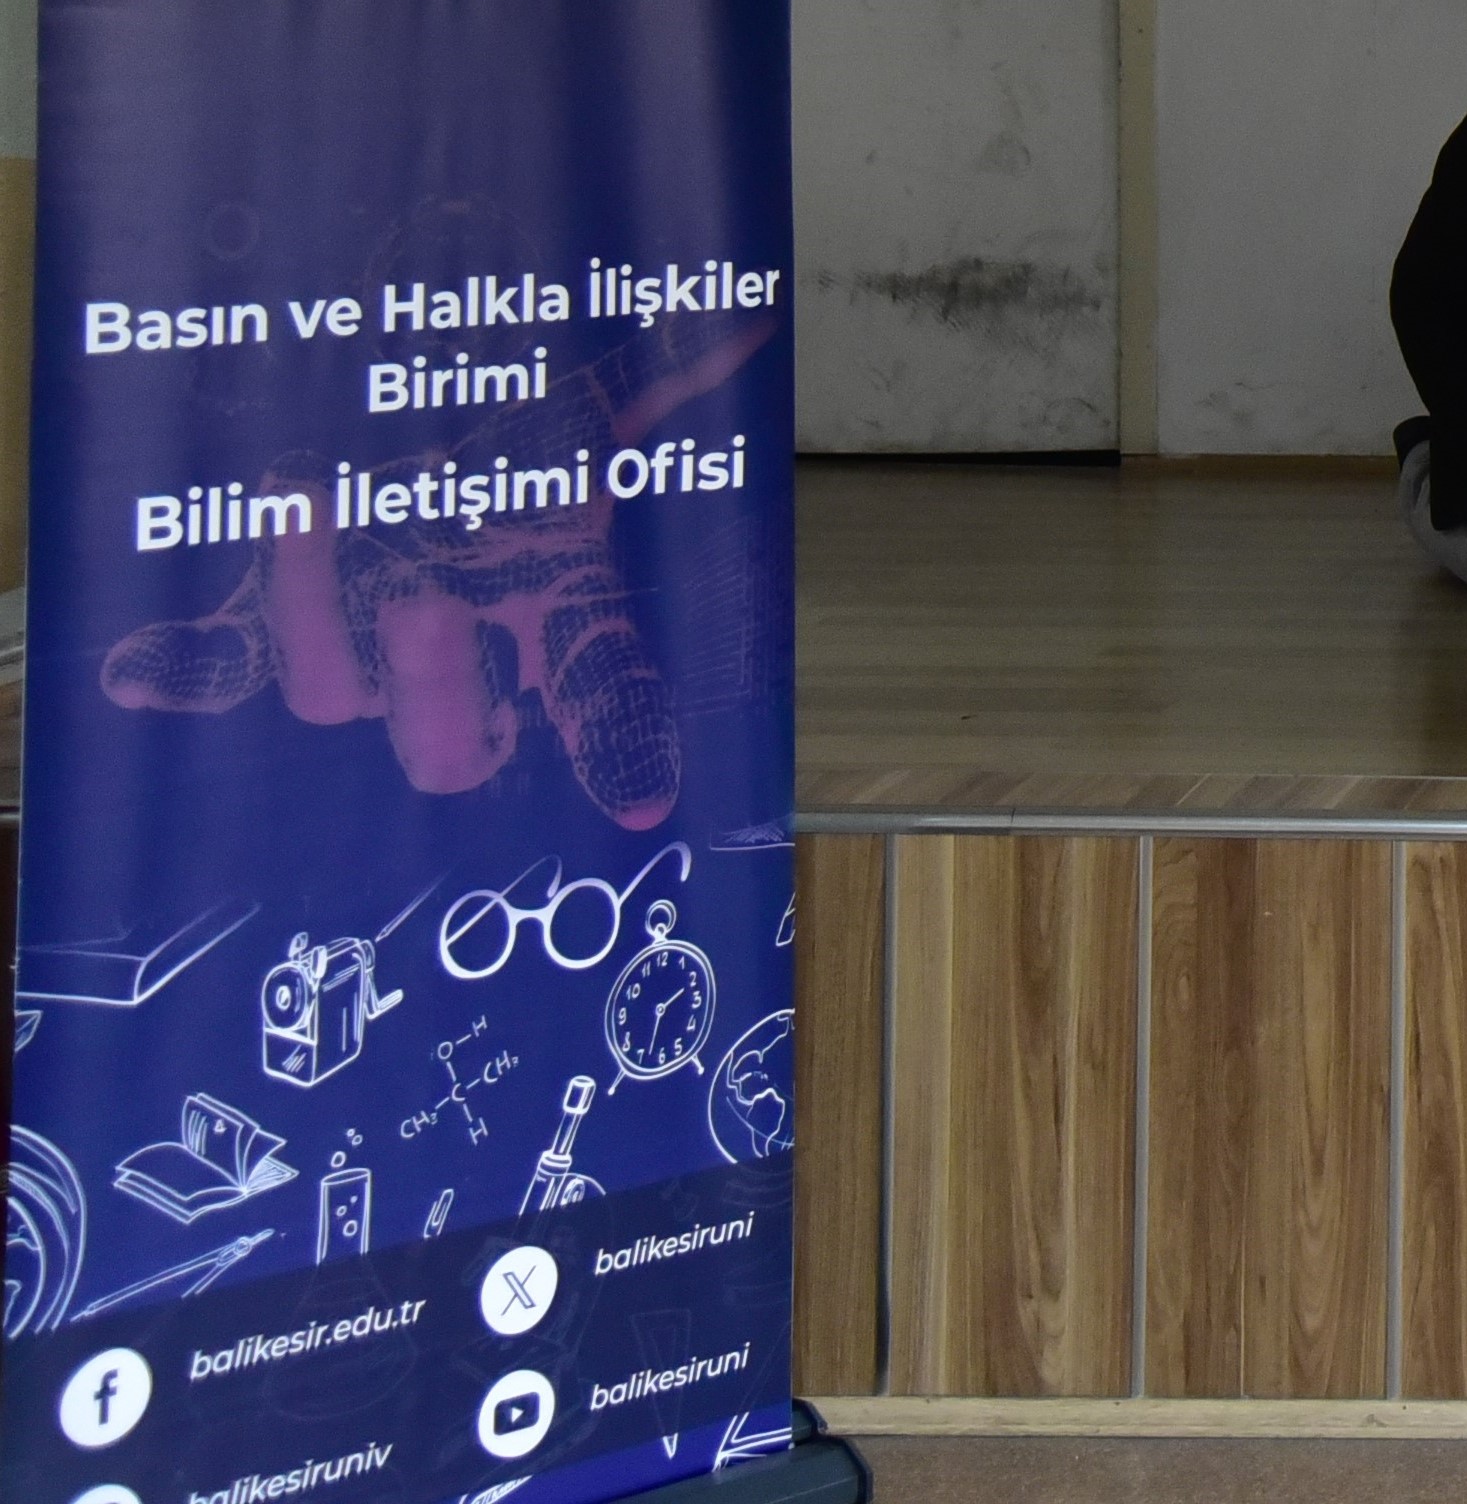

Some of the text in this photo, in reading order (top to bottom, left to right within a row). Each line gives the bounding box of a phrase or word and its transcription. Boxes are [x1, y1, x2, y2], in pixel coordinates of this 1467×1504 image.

[84, 256, 781, 355] Basın ve Halkla İlişkiler
[367, 346, 549, 414] Birimi
[135, 434, 747, 552] Bilim İletişimi Ofisi
[656, 951, 669, 967] 12
[678, 955, 686, 970] 1
[641, 960, 651, 978] 11
[689, 971, 697, 987] 2
[626, 982, 641, 1001] 10
[691, 990, 702, 1010] 3
[472, 1014, 488, 1037] H
[618, 1007, 627, 1026] 9
[686, 1014, 697, 1032] 4
[437, 1041, 453, 1060] O
[622, 1031, 631, 1052] 8
[674, 1037, 683, 1056] 5
[637, 1048, 645, 1064] 7
[658, 1047, 666, 1064] 6
[469, 1117, 488, 1146] H
[594, 1211, 755, 1276] balikesiruni
[190, 1299, 427, 1381] balikesir.edu.tr
[590, 1341, 751, 1411] balikesiruni
